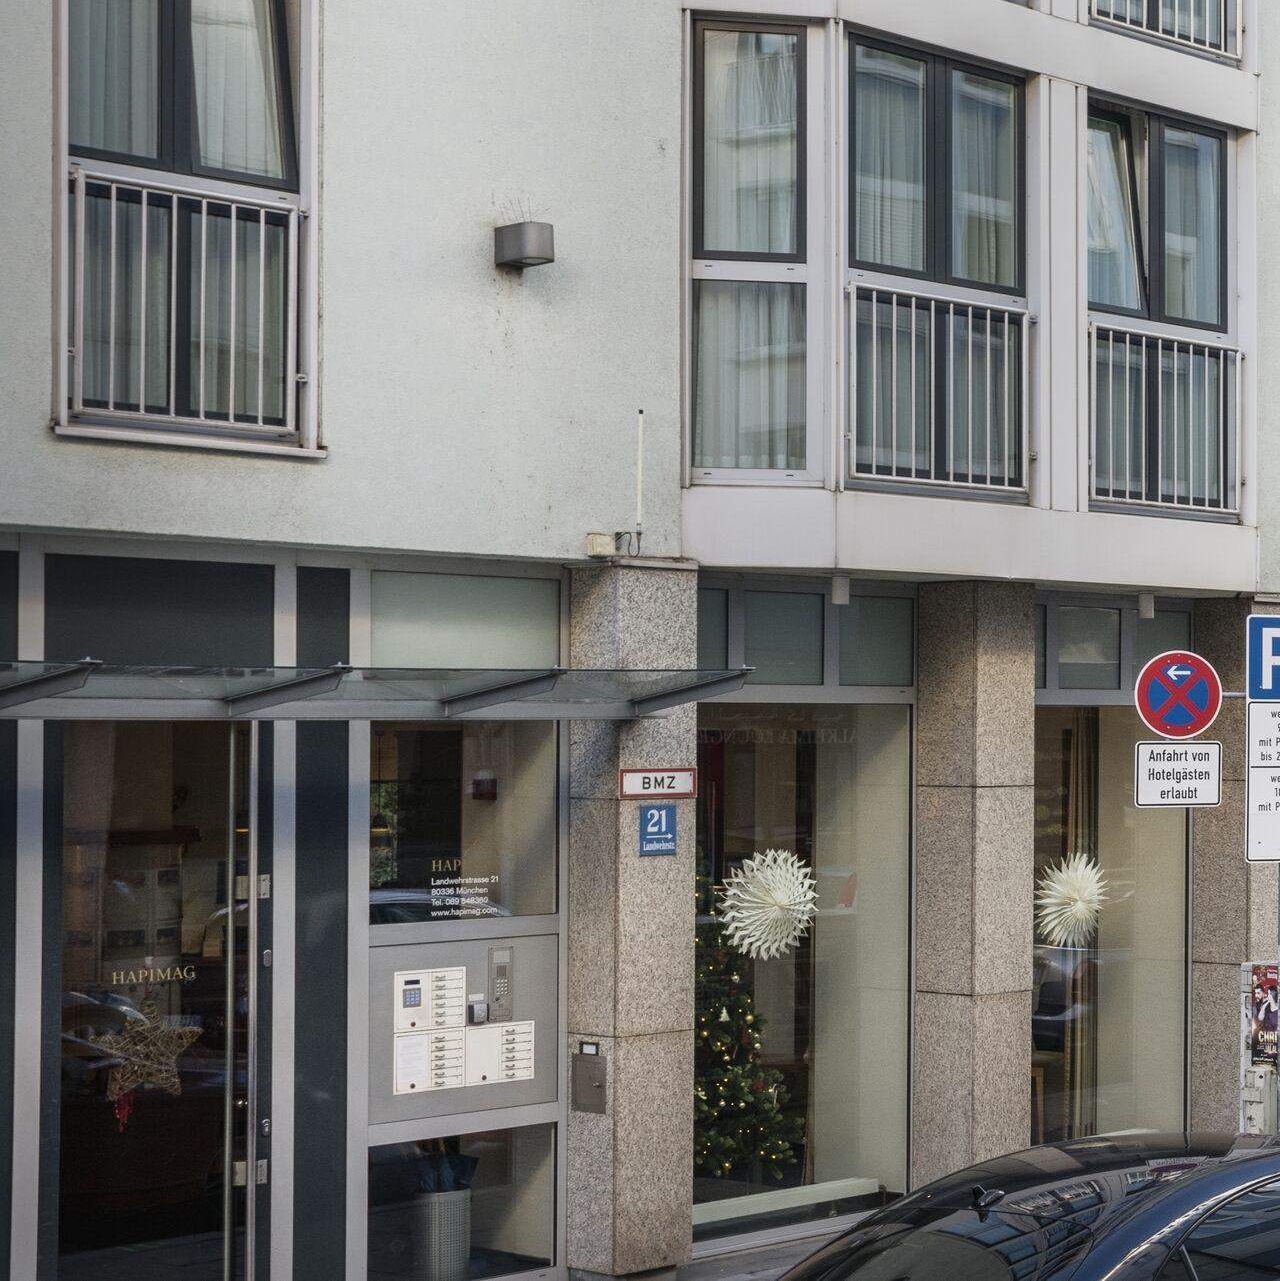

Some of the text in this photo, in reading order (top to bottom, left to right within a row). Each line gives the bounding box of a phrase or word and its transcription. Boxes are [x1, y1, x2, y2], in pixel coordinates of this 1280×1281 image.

[1258, 738, 1272, 747] mit
[1148, 749, 1210, 762] Anfahrt von
[1260, 752, 1272, 761] bis
[1276, 752, 1280, 760] 2
[1148, 767, 1210, 784] Hotelgästen
[642, 776, 676, 790] BMZ
[1160, 787, 1198, 799] erlaubt
[1258, 802, 1271, 812] mit
[647, 809, 667, 832] 21
[431, 875, 499, 886] Landwehrstrasse 21
[431, 886, 489, 896] 80336 München
[431, 898, 444, 906] Tel.
[445, 898, 460, 906] 089
[431, 907, 498, 917] www.hapimag.com
[112, 965, 196, 985] HAPIMAG
